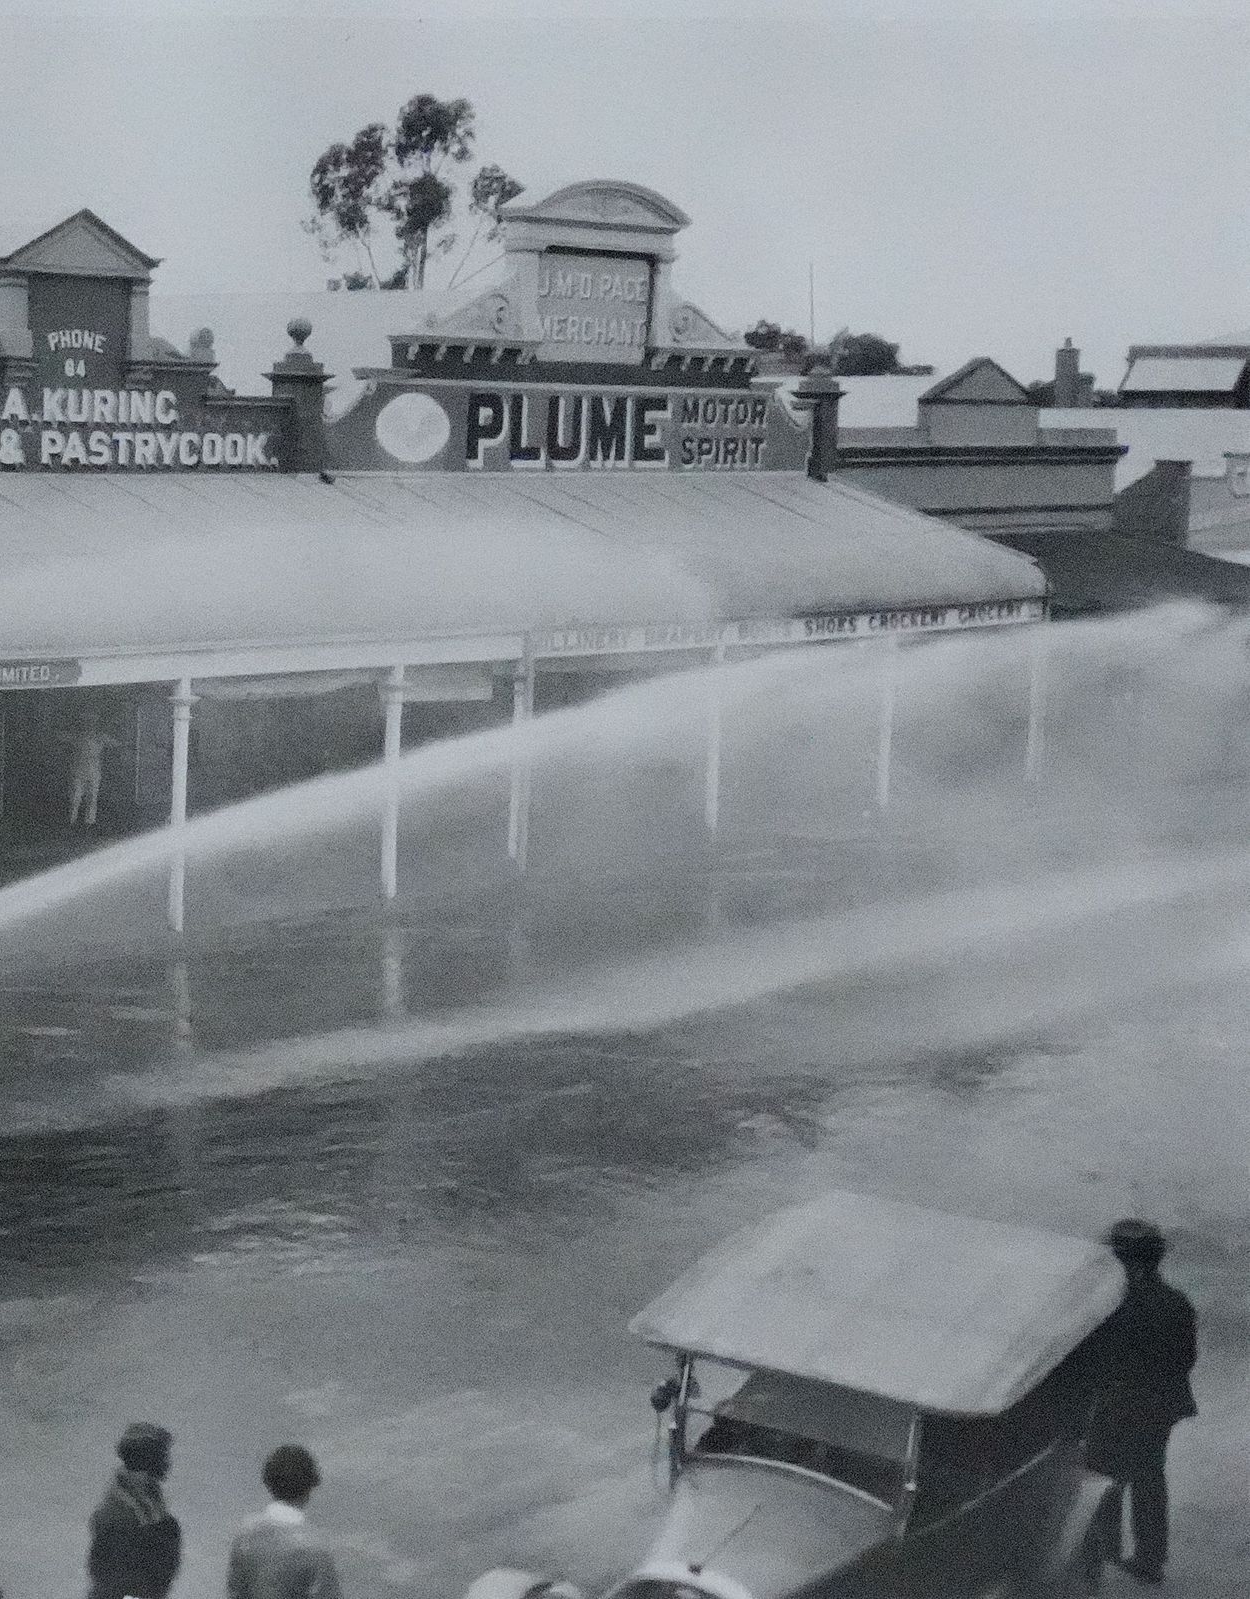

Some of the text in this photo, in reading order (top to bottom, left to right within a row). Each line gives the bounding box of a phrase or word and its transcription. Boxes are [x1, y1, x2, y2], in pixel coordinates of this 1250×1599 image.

[47, 328, 107, 354] PHONE
[681, 396, 768, 429] MOTOR
[465, 392, 673, 469] PLUME
[681, 436, 767, 469] SPIRIT
